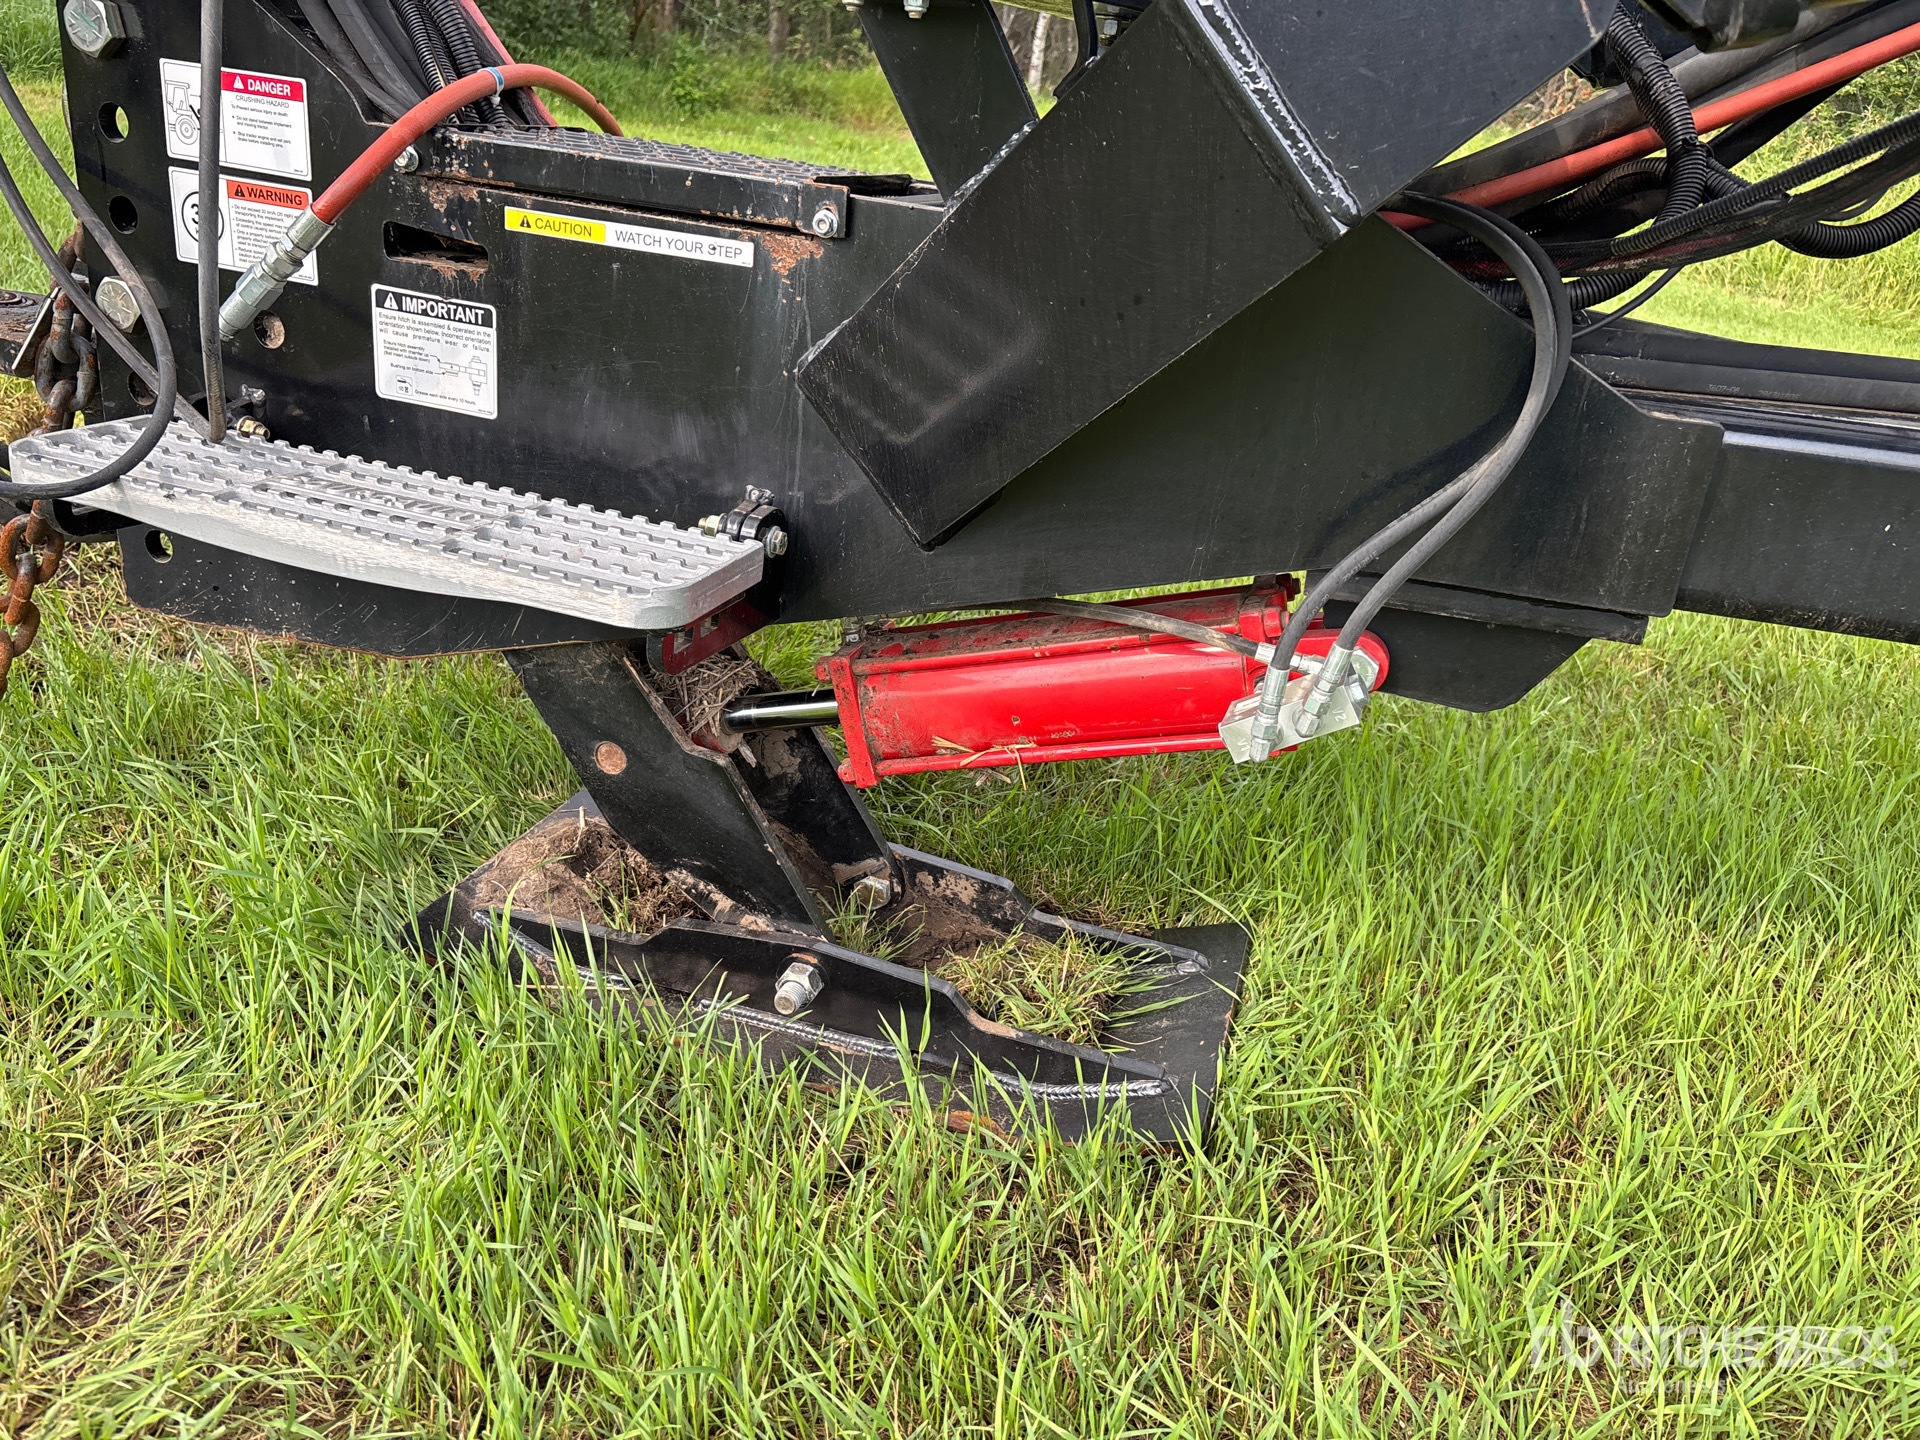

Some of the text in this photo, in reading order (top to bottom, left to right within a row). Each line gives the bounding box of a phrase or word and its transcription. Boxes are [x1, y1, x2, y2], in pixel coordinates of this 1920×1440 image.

[248, 79, 291, 96] DANGER
[236, 95, 289, 108] CRUSHING HAZARD
[246, 186, 302, 206] WARNING
[235, 210, 256, 218] transporting
[535, 218, 742, 259] CAUTION WATCH YOUR STEP
[402, 296, 484, 325] IMPORTANT
[379, 312, 396, 320] Ensure
[418, 319, 445, 330] assembled
[453, 326, 475, 336] operated
[379, 321, 405, 329] orientation
[406, 324, 422, 332] shown
[465, 336, 491, 345] orientation
[413, 334, 440, 343] premature
